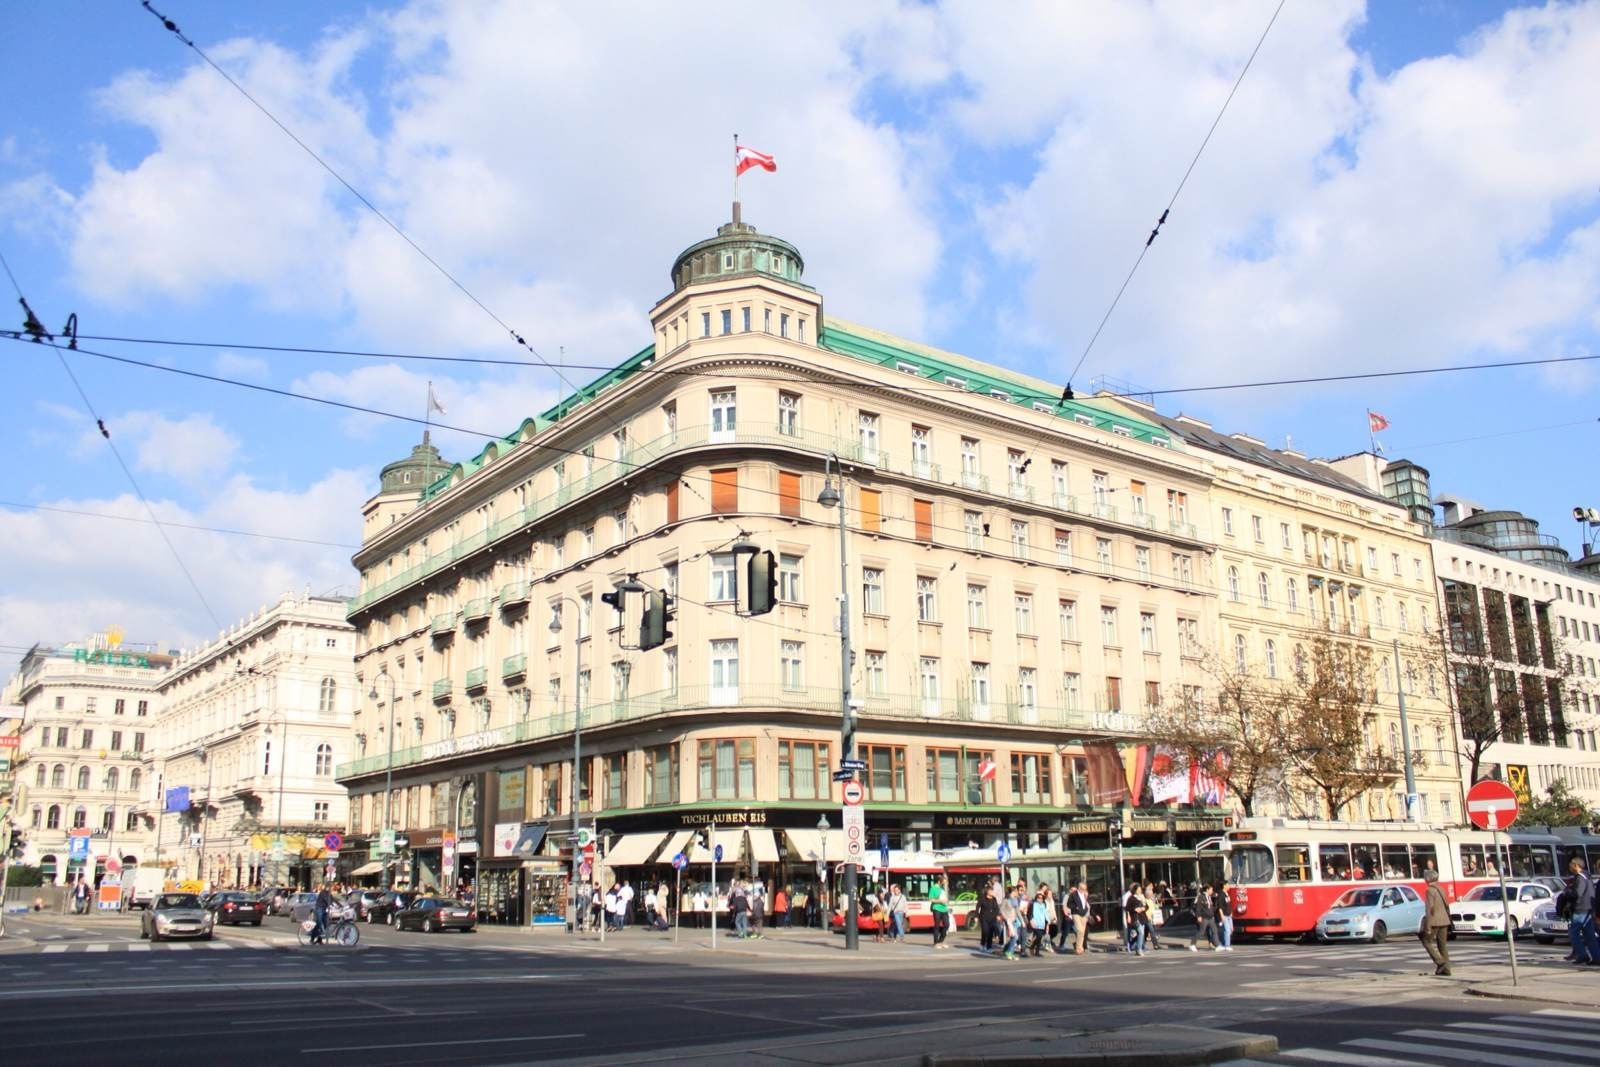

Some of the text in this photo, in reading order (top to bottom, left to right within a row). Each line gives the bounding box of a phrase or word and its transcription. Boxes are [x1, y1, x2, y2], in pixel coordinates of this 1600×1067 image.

[75, 648, 150, 668] ROLEX
[681, 813, 766, 824] TUCHLAUBEN EIS
[954, 817, 1002, 825] BANK AUSTRIA
[73, 840, 85, 853] P
